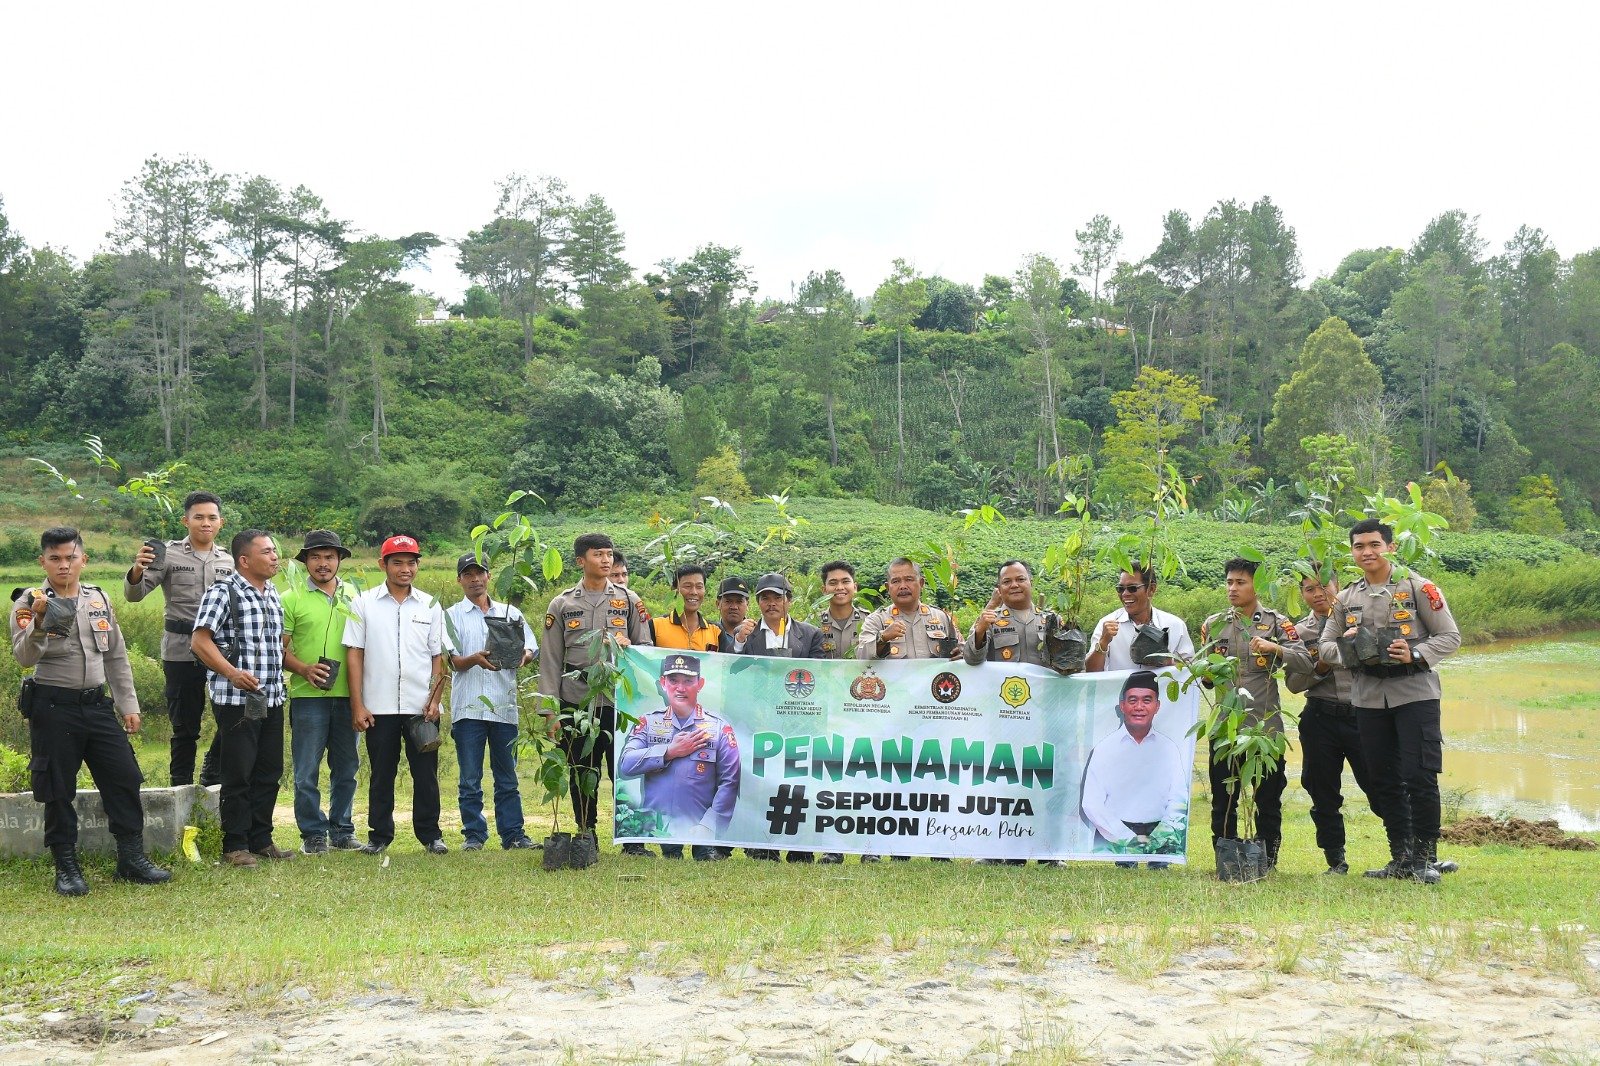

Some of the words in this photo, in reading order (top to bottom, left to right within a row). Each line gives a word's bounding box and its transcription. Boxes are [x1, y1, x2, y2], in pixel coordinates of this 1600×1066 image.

[752, 731, 1055, 790] PENANAMAN
[815, 790, 950, 813] SEPULUH
[957, 796, 1034, 816] JUTA
[815, 816, 919, 836] POHON
[926, 817, 992, 840] Bersama
[998, 820, 1035, 839] Polri
